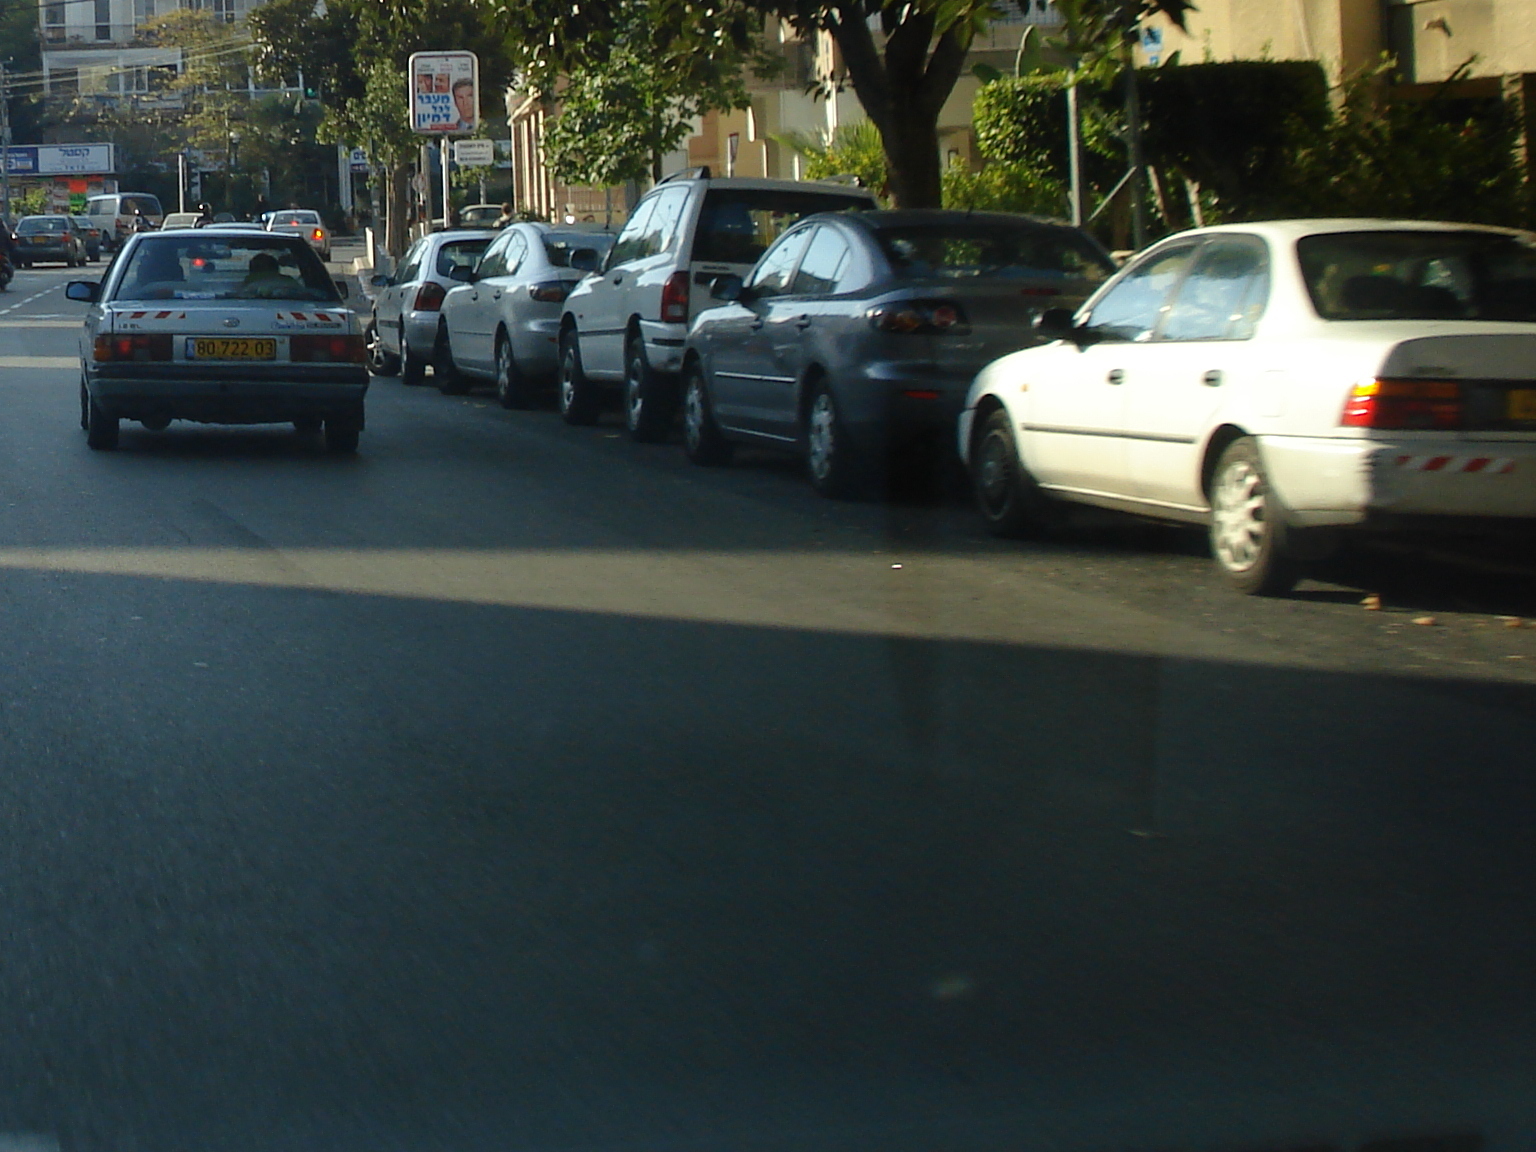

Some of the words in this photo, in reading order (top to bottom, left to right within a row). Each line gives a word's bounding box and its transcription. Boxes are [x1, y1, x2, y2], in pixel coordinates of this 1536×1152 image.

[417, 94, 450, 104] מעבר
[432, 104, 450, 112] לכל
[417, 113, 451, 127] דמיון
